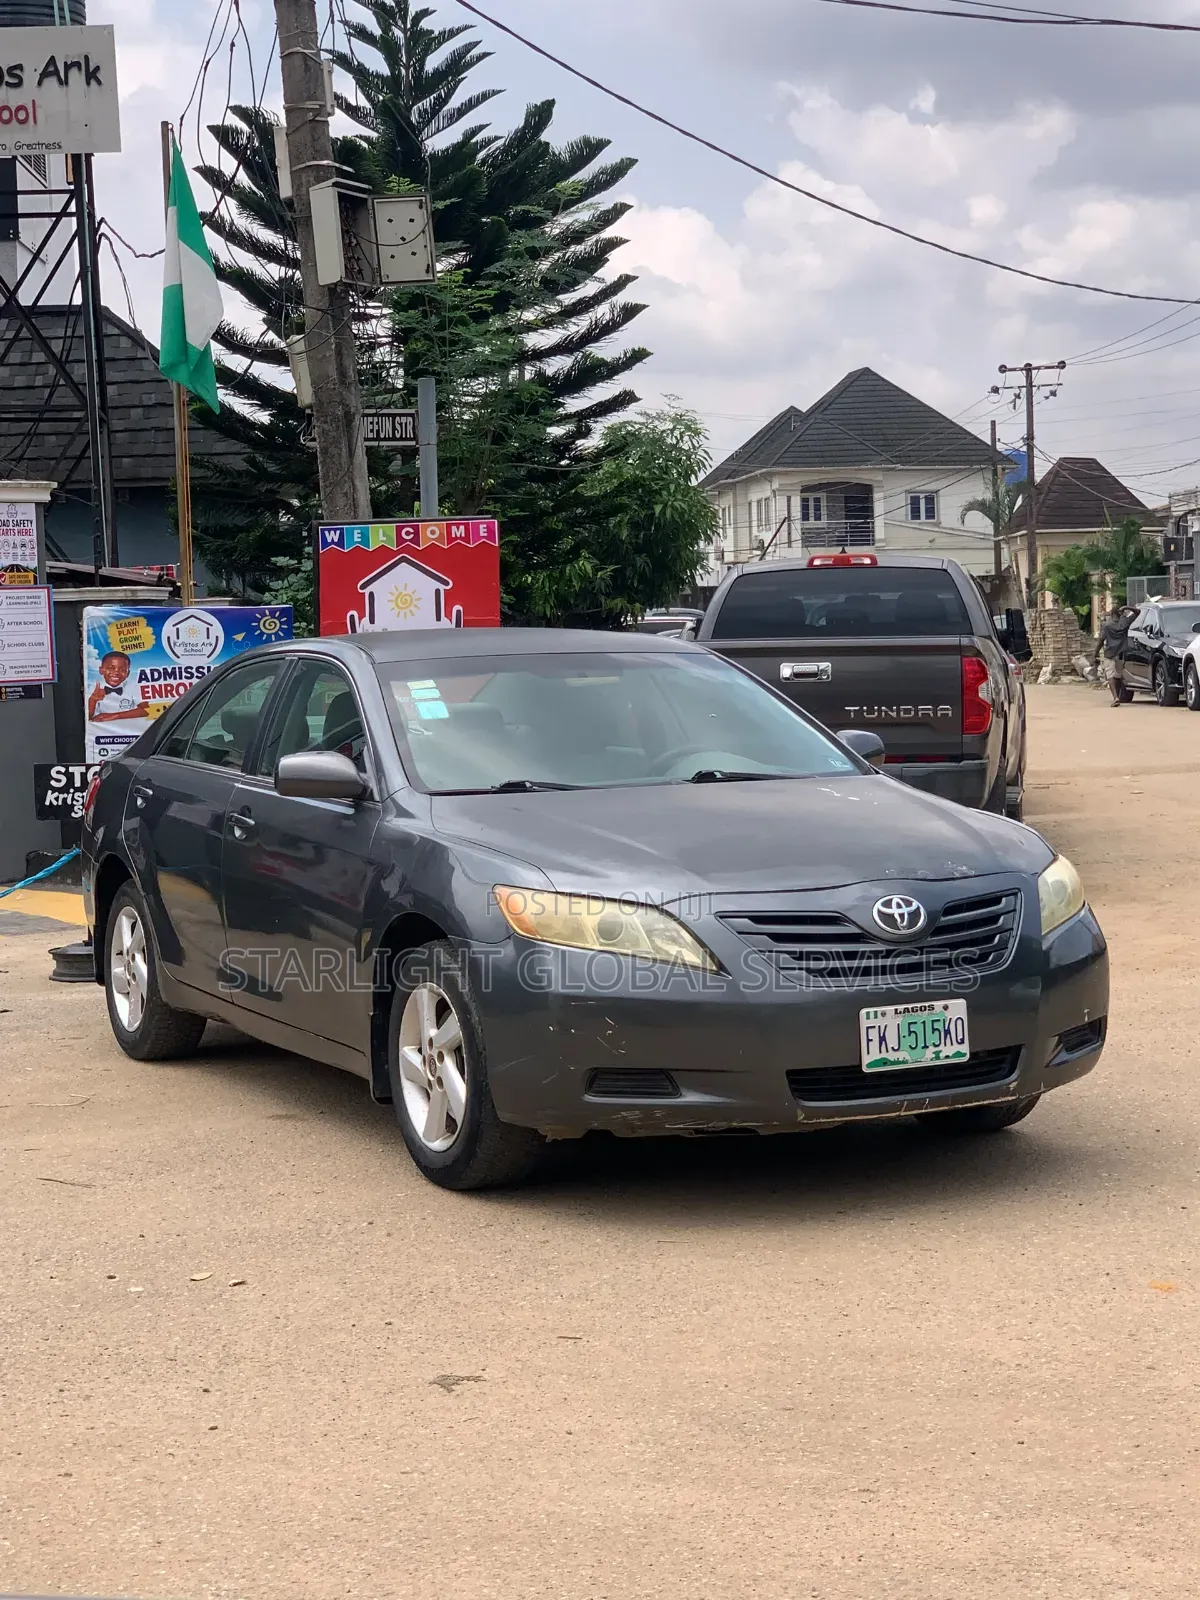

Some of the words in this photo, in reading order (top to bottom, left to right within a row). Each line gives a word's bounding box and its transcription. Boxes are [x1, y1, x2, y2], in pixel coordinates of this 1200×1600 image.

[0, 63, 24, 88] s
[37, 54, 102, 87] Ark
[14, 140, 62, 151] Greatness
[395, 416, 414, 438] STR
[11, 519, 33, 528] SAFETY
[17, 528, 34, 537] HERE!
[324, 524, 488, 543] WELCOME
[116, 620, 140, 629] LEARN!
[117, 628, 138, 636] PLAY!
[119, 634, 142, 644] GROW!
[173, 640, 199, 648] Kristos
[120, 642, 145, 652] SHINE!
[844, 705, 952, 719] TUNDRA
[894, 1004, 935, 1015] LAGOS
